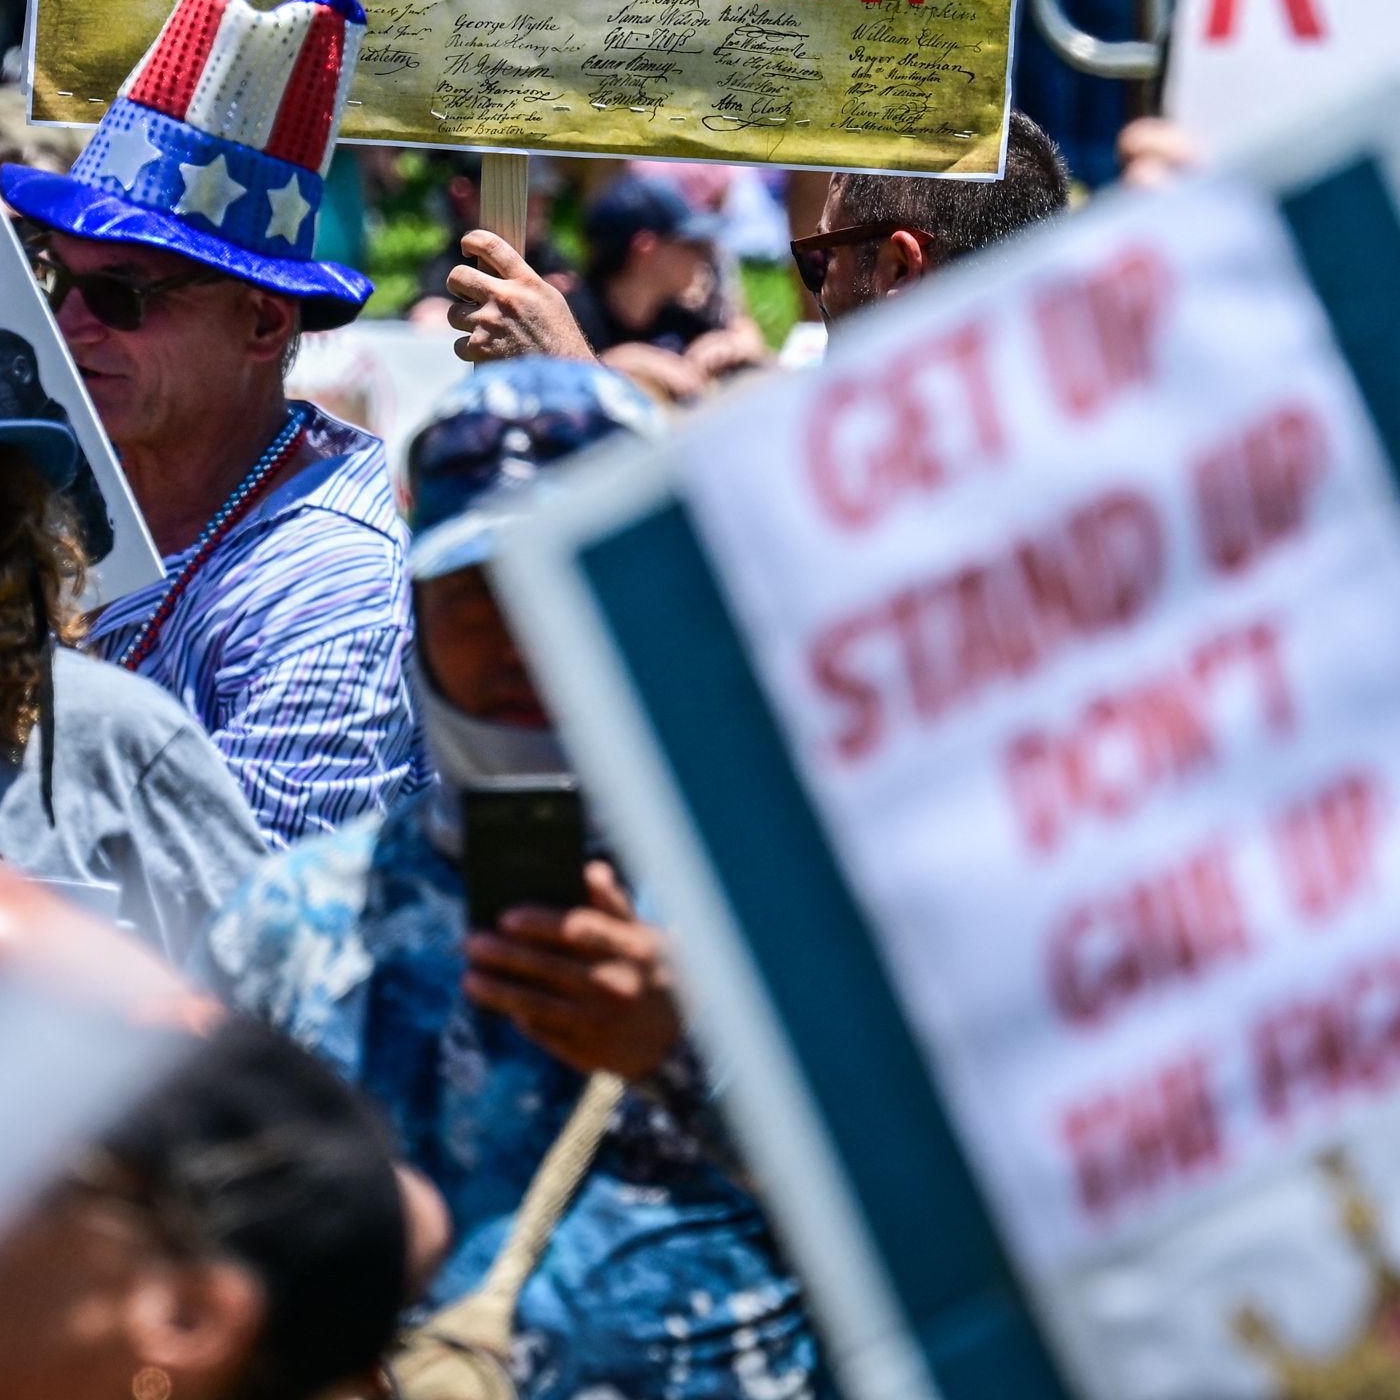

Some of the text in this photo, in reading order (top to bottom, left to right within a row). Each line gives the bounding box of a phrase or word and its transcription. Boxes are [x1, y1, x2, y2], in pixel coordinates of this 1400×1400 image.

[803, 242, 1175, 537] GET UP
[805, 398, 1338, 772] STAND UP
[996, 612, 1300, 862] DON'T
[1275, 763, 1396, 925] UP
